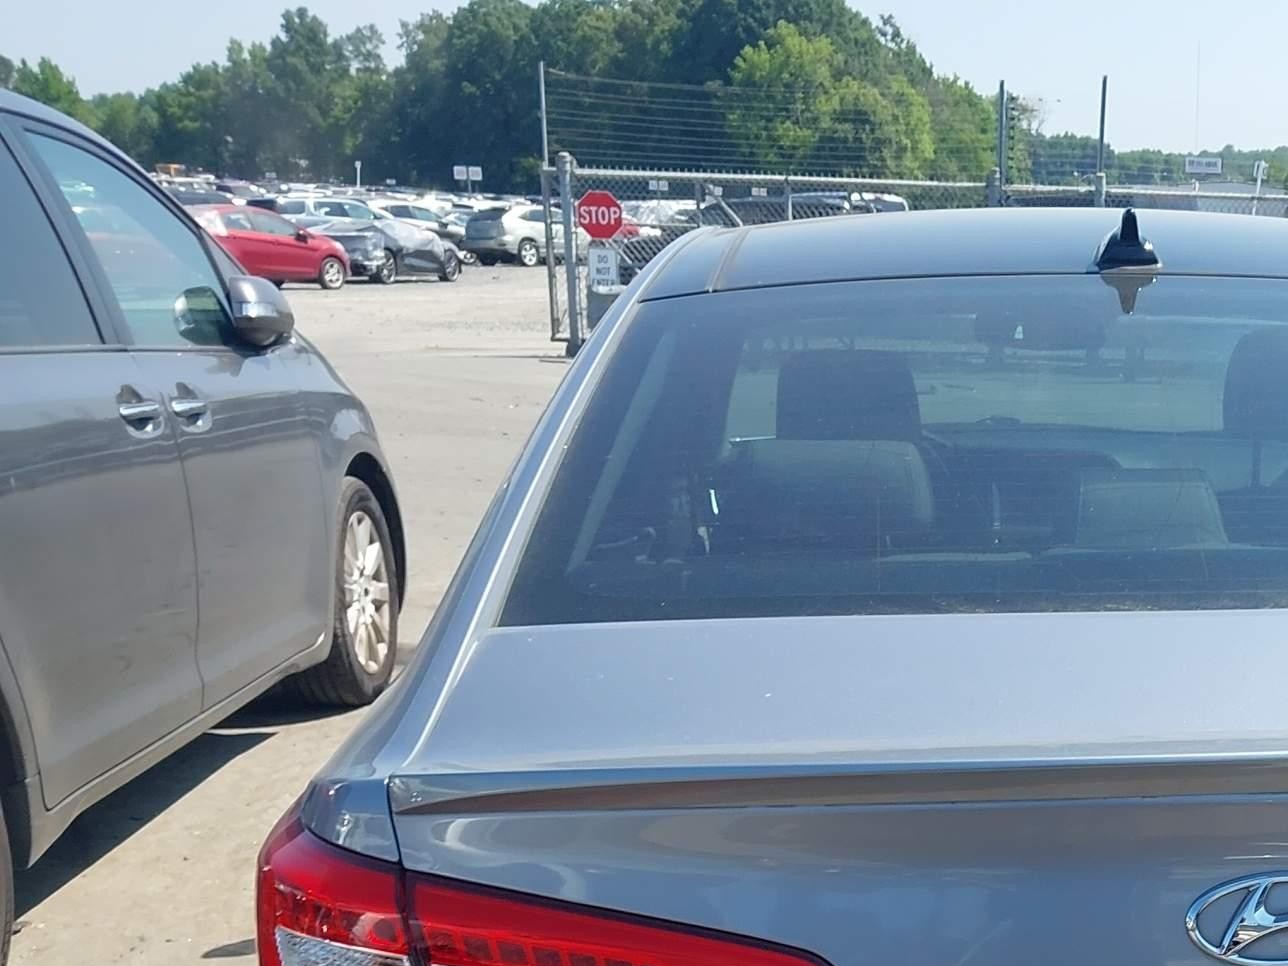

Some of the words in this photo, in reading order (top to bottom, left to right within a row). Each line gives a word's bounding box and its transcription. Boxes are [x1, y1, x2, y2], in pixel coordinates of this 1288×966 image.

[579, 206, 620, 225] STOP
[597, 254, 609, 264] DO
[596, 266, 610, 276] NOT
